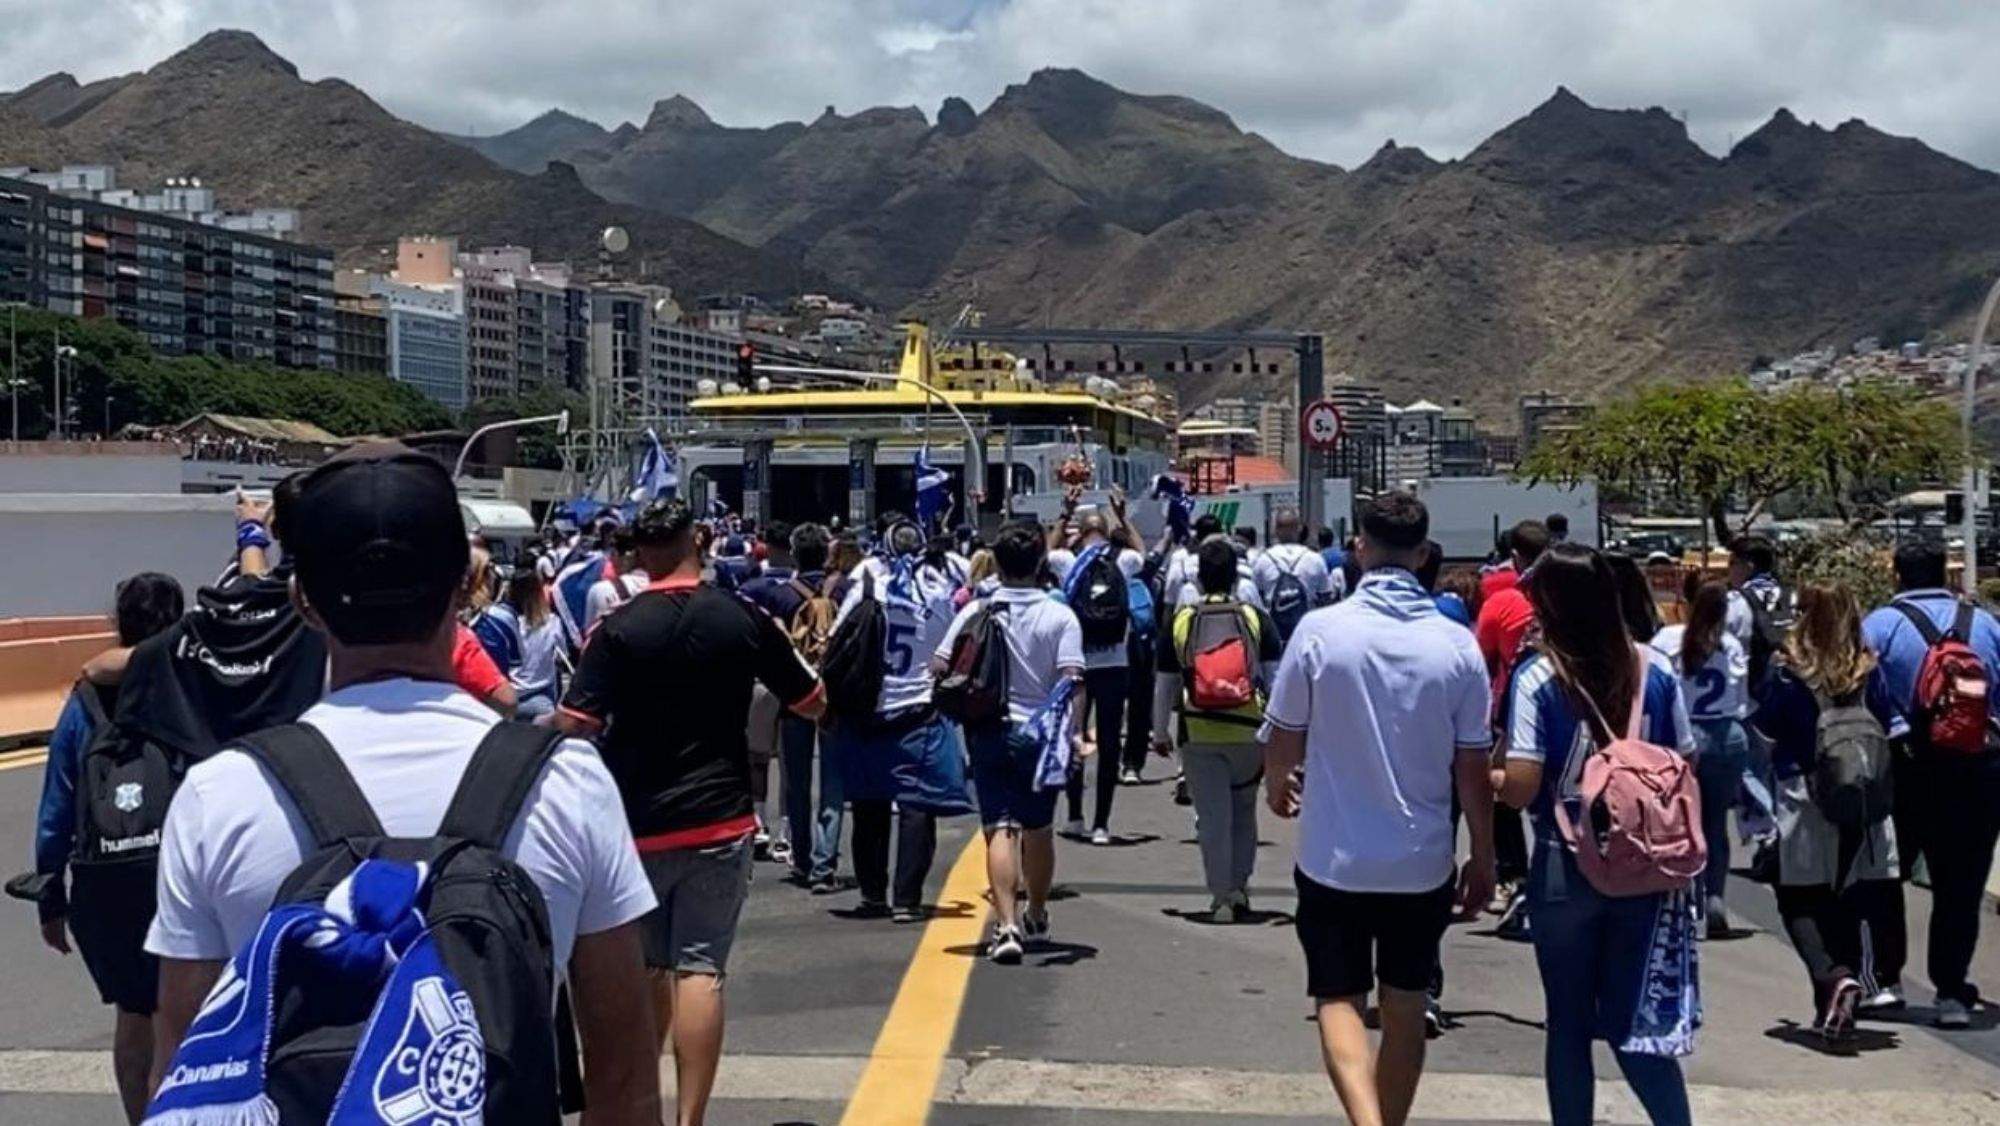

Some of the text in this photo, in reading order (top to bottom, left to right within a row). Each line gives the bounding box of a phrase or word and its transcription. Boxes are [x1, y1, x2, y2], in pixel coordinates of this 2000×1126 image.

[888, 623, 917, 676] 5
[1692, 667, 1726, 715] 2
[100, 829, 160, 853] hummel
